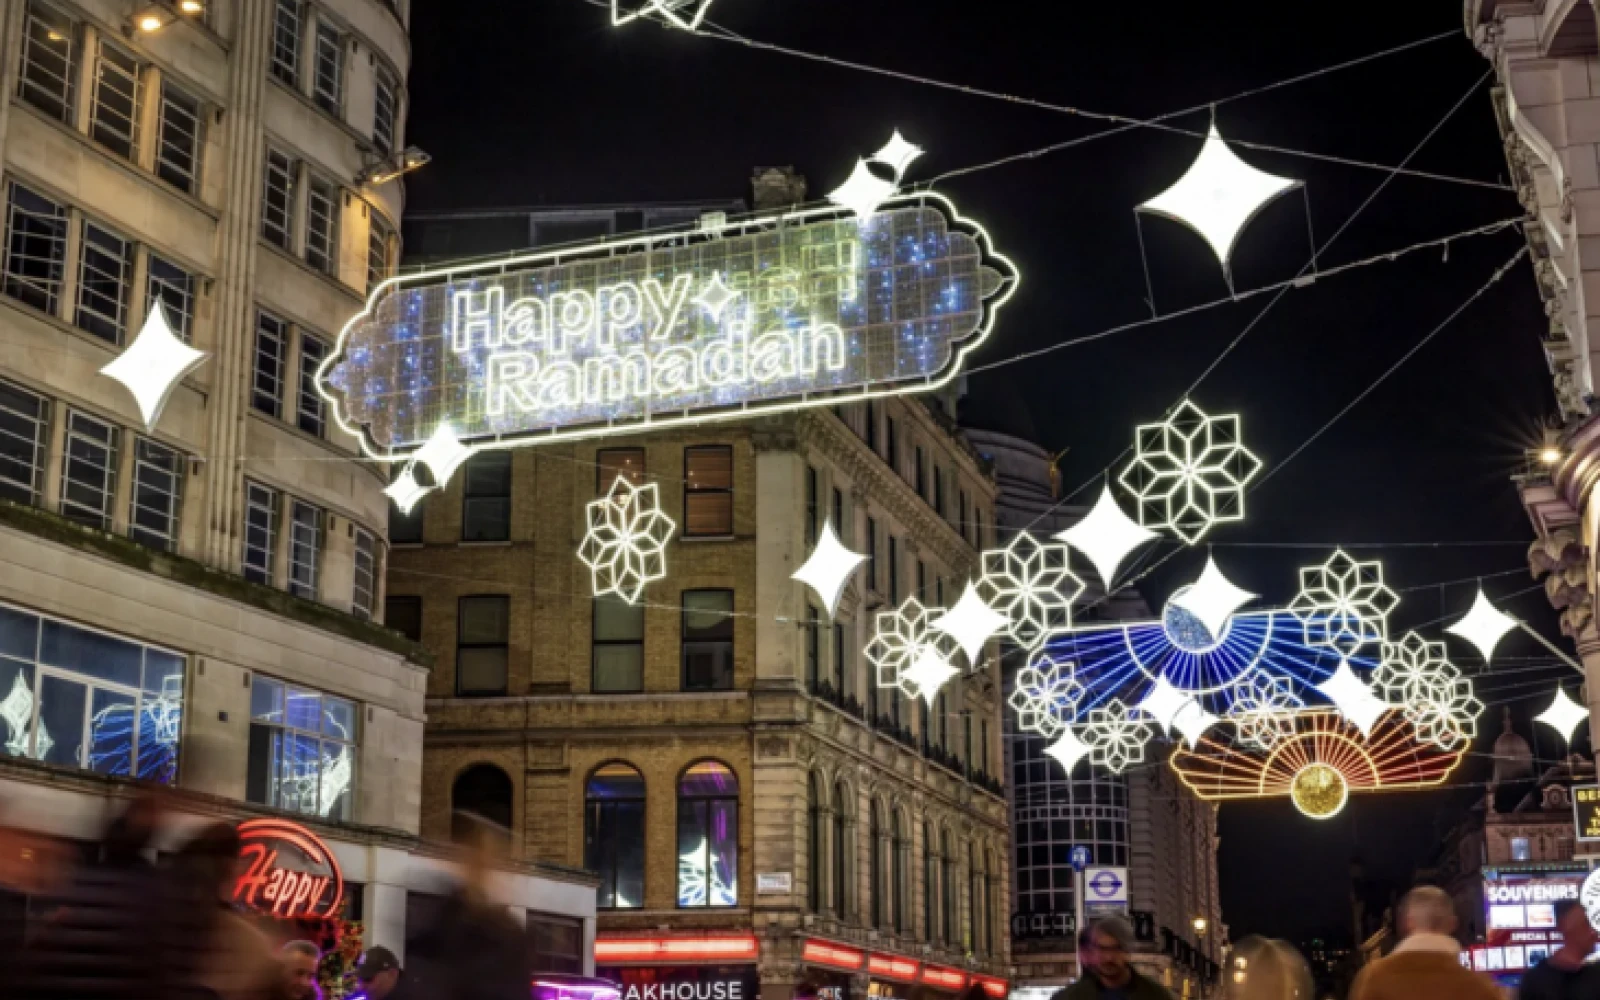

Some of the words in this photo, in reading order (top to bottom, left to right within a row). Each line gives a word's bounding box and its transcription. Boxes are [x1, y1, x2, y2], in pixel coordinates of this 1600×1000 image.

[451, 272, 693, 355] Happy
[484, 319, 846, 416] Ramadan
[233, 842, 330, 918] Happy
[1487, 884, 1579, 902] SOUVENIRS
